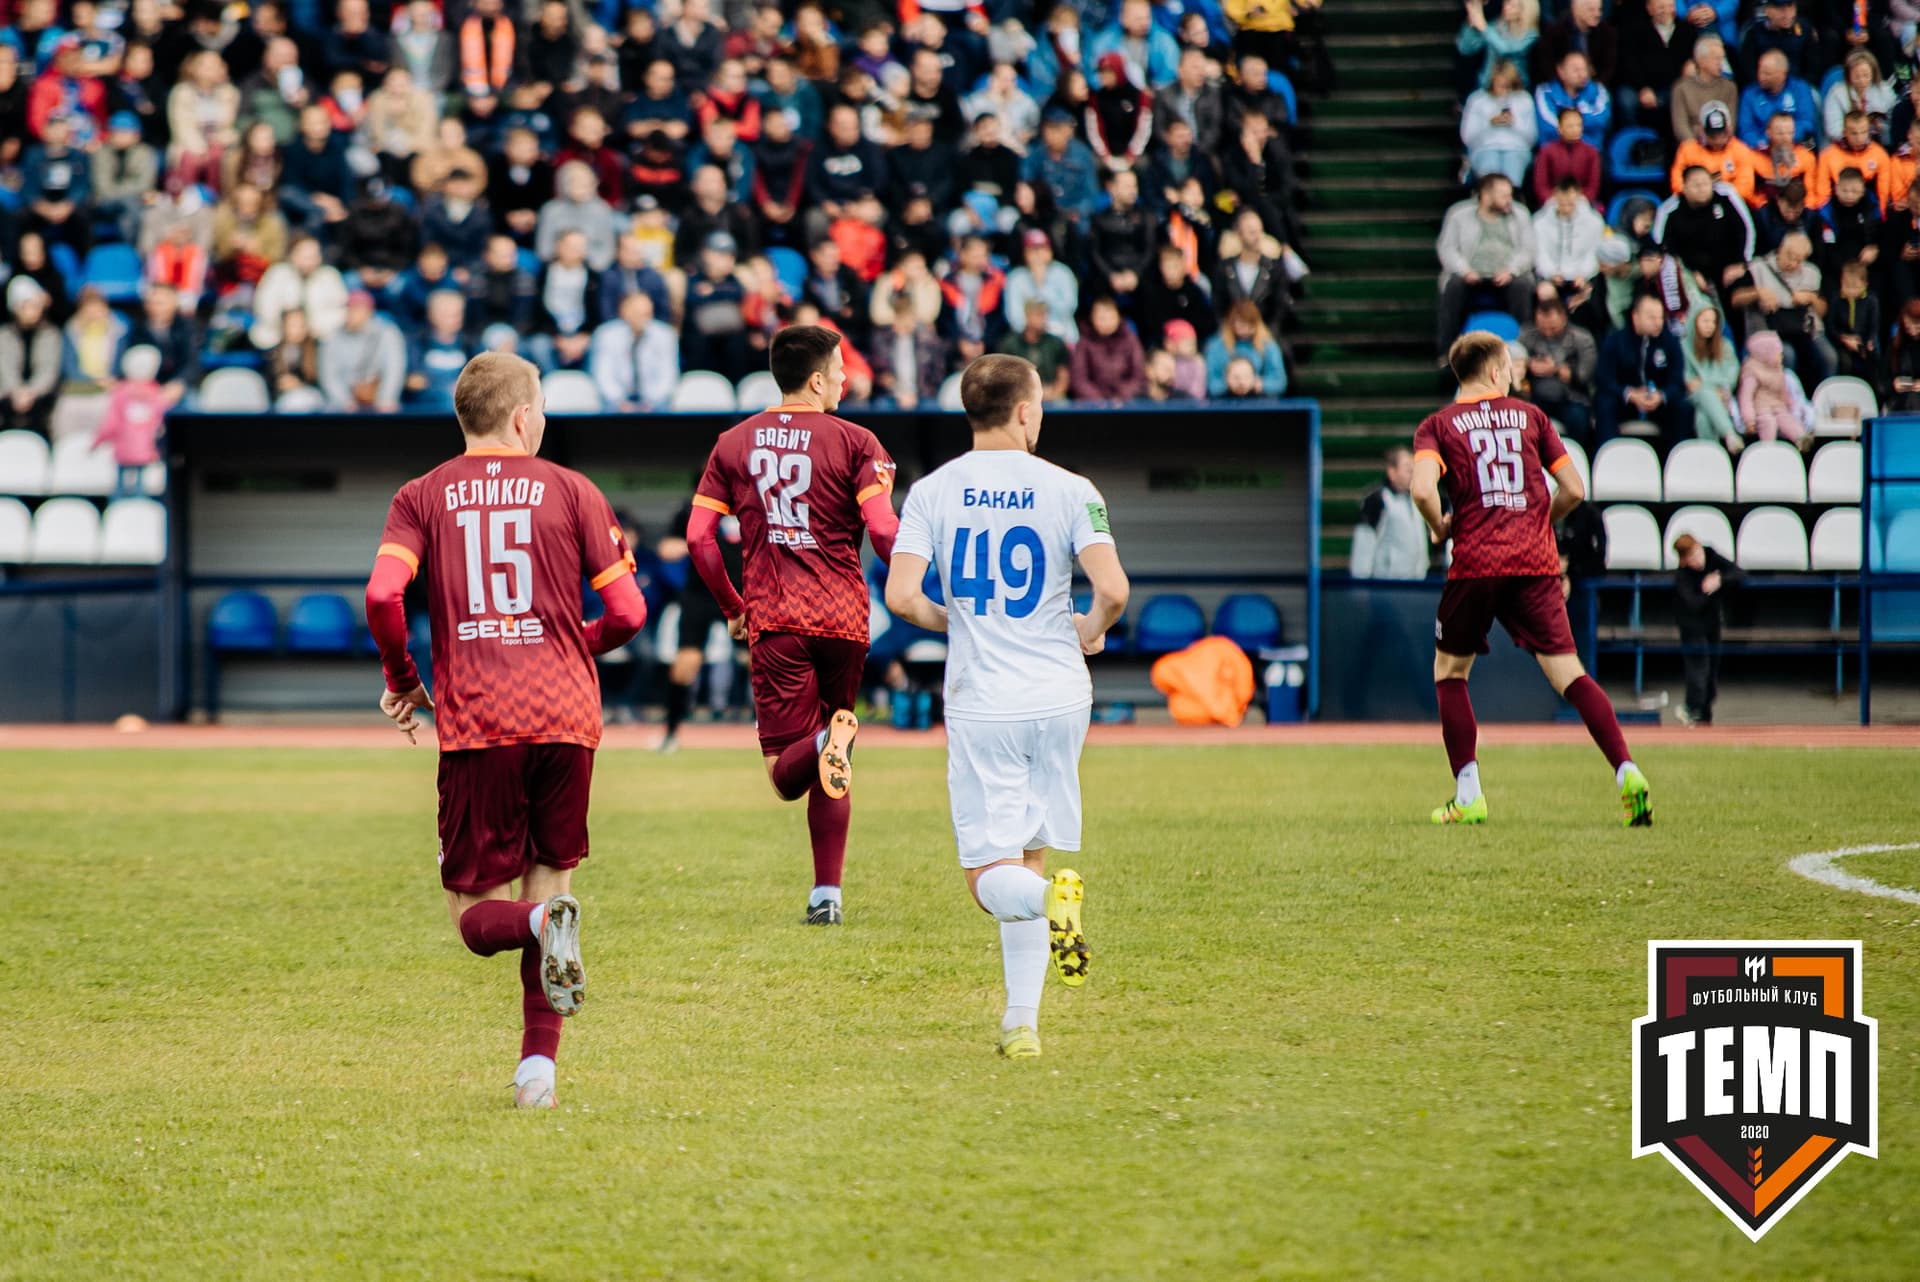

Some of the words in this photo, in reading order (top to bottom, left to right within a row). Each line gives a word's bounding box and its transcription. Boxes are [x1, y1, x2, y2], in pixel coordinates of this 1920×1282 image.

[755, 427, 812, 451] БАБИЧ
[1469, 428, 1525, 494] 25
[445, 477, 546, 511] БЕЛИКОВ
[749, 448, 812, 530] 22
[963, 488, 1035, 510] БАКАЙ
[456, 509, 533, 615] 15
[951, 526, 1046, 618] 49
[457, 617, 544, 641] SEUS
[501, 638, 522, 646] Export
[523, 636, 544, 645] Union
